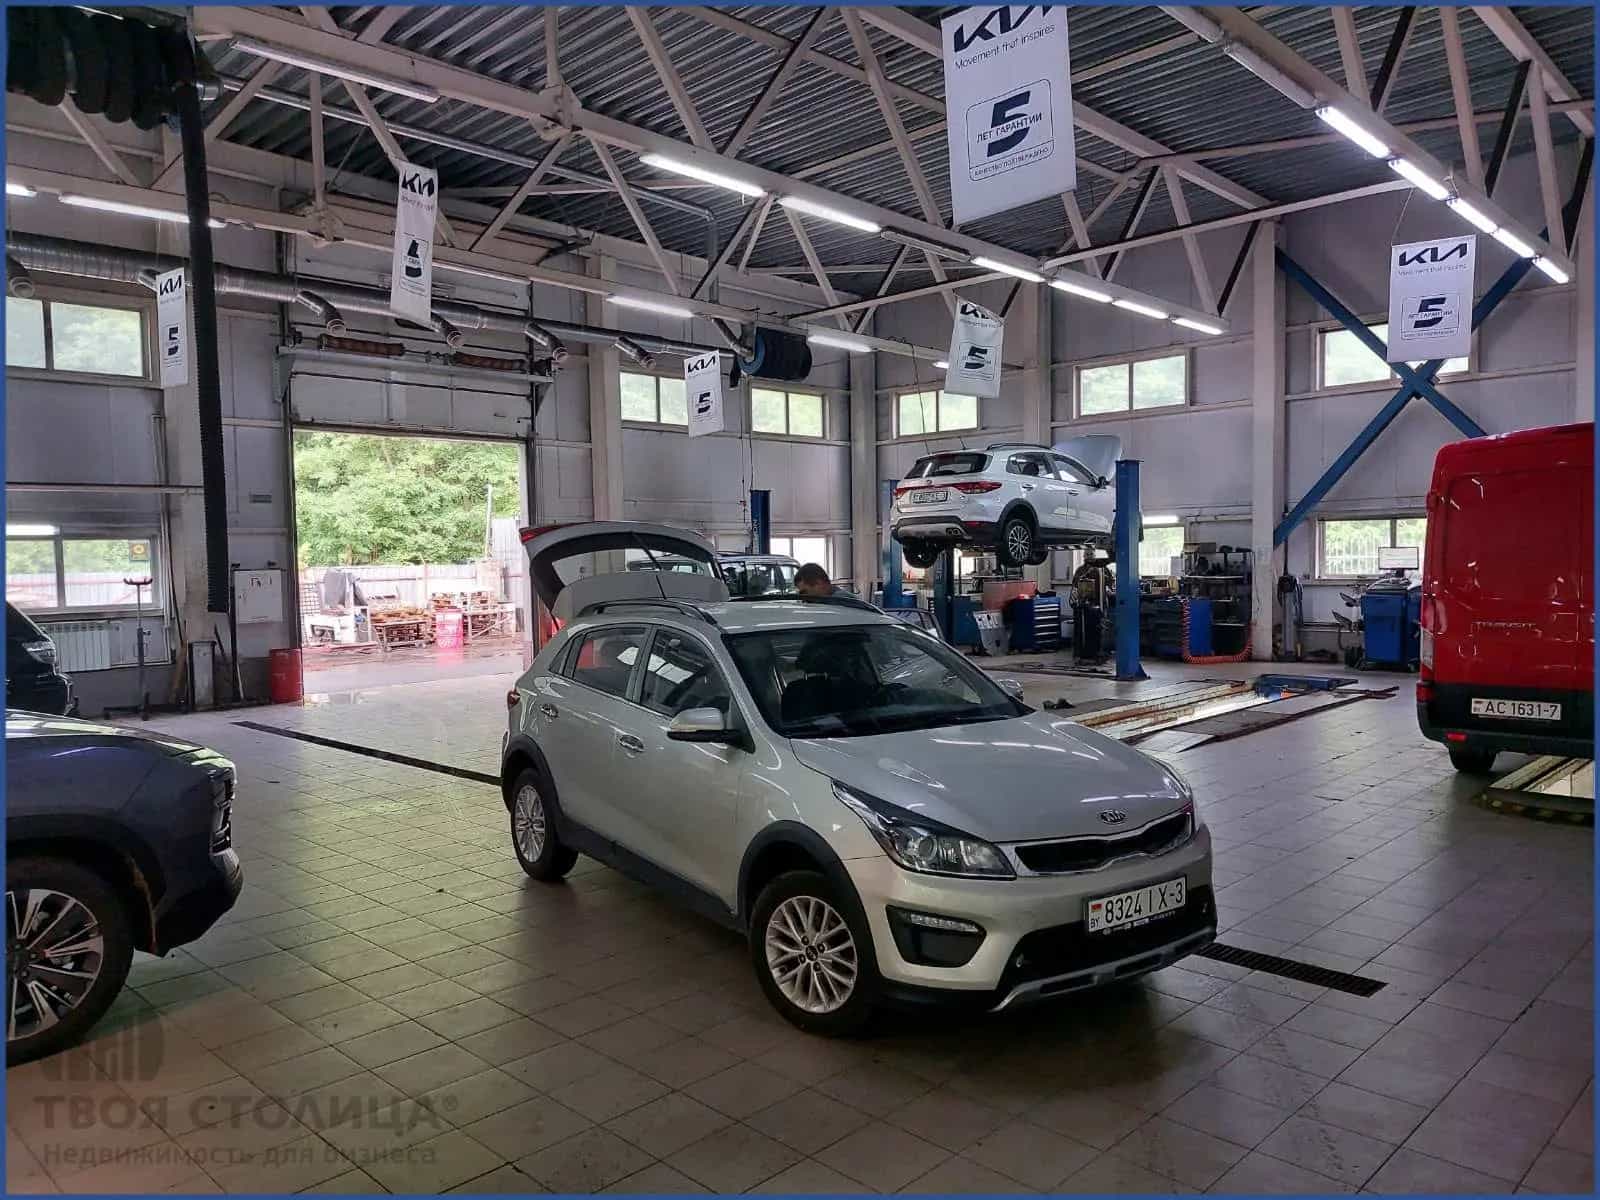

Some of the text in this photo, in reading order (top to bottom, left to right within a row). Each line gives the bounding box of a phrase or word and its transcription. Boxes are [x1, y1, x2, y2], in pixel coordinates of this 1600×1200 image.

[955, 24, 1055, 70] Movement that inspires
[976, 112, 1042, 144] ЛЕТ ГАРАНТИИ
[987, 90, 1031, 157] 5
[1399, 243, 1468, 267] KIA
[160, 275, 182, 296] KIA
[1413, 297, 1446, 329] 5
[688, 355, 716, 373] KIA
[1485, 701, 1507, 714] AC
[1511, 703, 1558, 718] 1631-7
[1105, 891, 1142, 924] 8324
